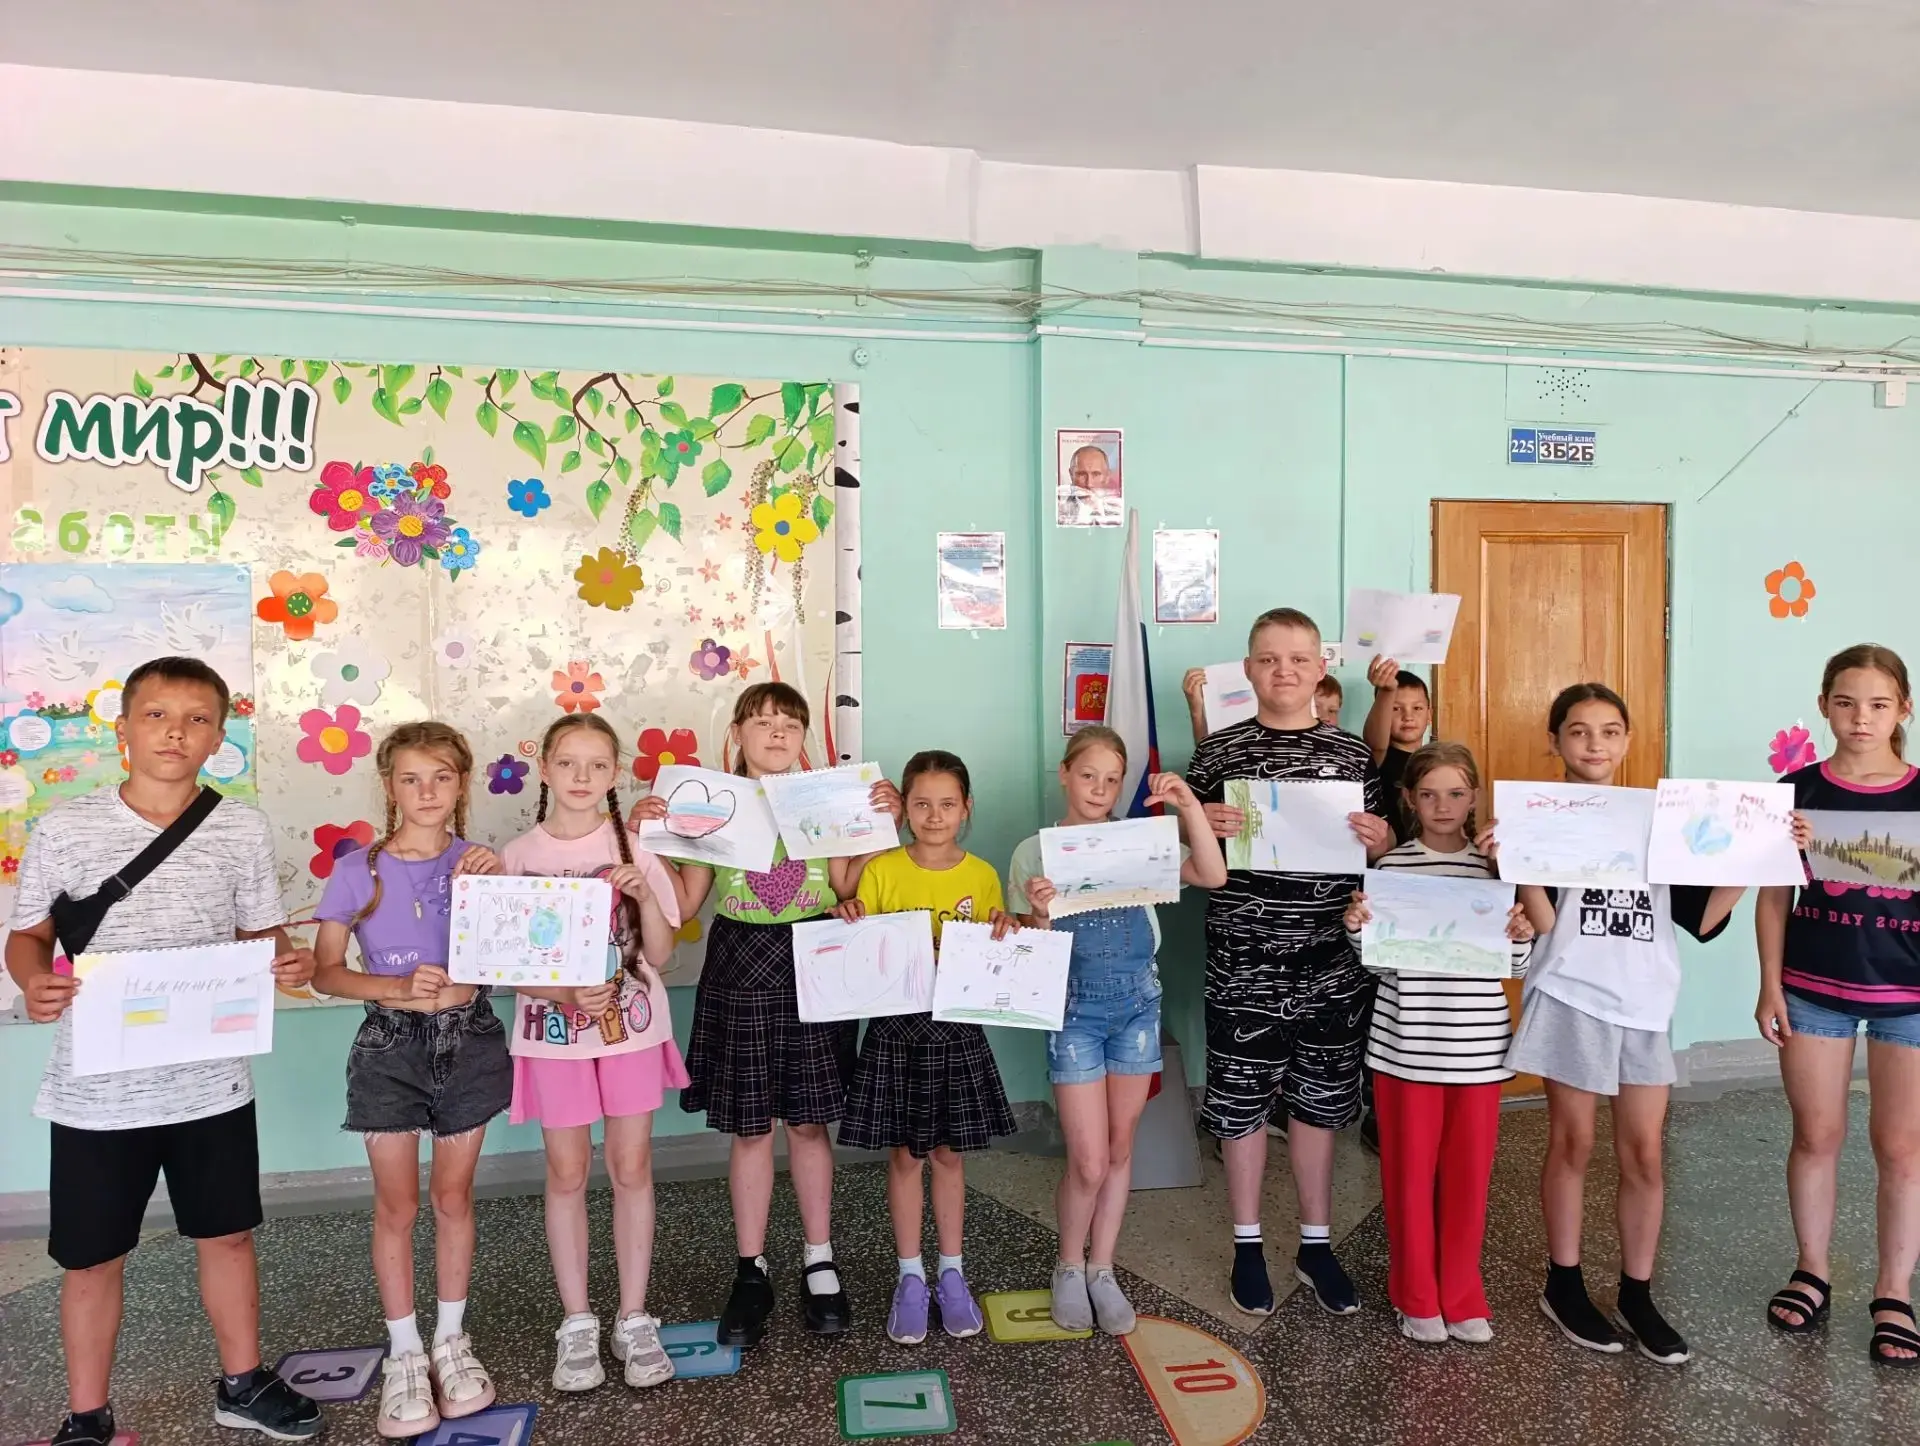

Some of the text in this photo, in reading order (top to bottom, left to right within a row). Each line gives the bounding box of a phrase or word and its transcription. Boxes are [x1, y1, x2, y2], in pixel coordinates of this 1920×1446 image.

[42, 383, 313, 487] мир!!!
[1538, 432, 1573, 442] Учебный
[1511, 439, 1535, 454] 225
[1828, 910, 1864, 926] DAY
[662, 1341, 717, 1358] 6
[291, 1366, 355, 1384] 3
[1165, 1359, 1237, 1393] 10
[864, 1393, 927, 1409] 7
